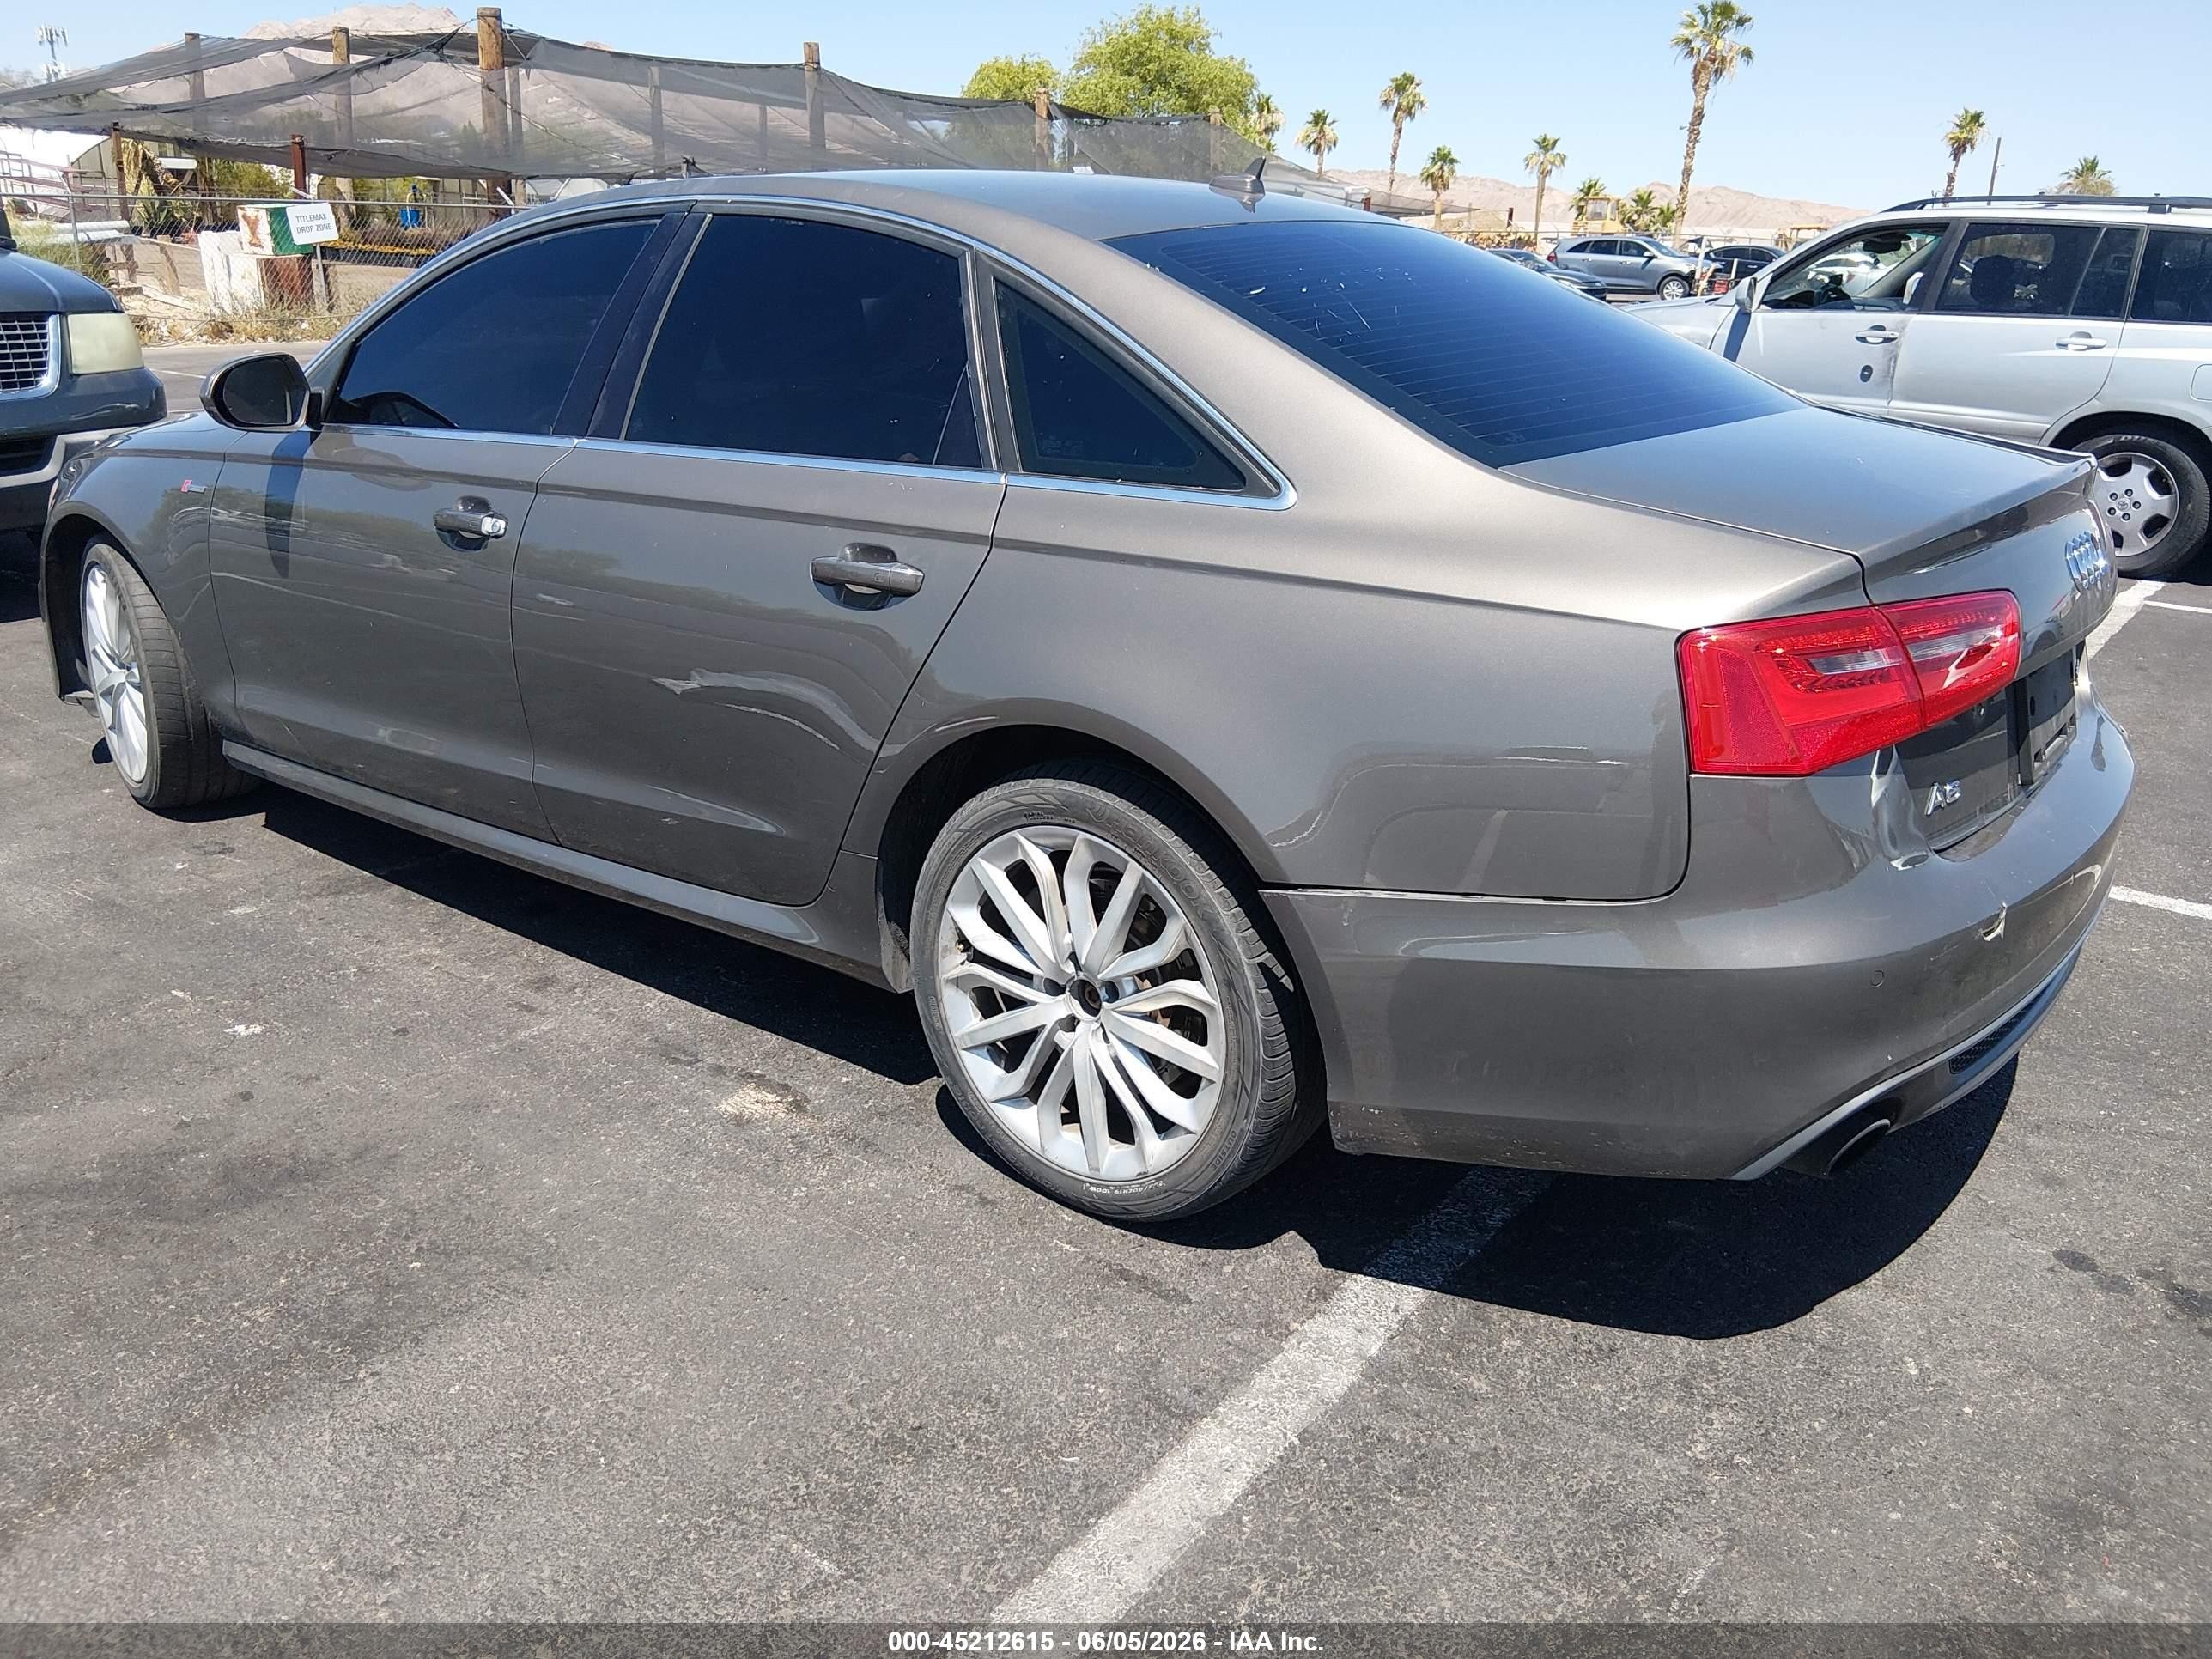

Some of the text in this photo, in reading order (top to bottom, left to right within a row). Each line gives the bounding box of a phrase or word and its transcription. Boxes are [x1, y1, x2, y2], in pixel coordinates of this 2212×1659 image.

[295, 213, 327, 223] TITLEMAX
[296, 222, 333, 234] DROP ZONE
[1924, 780, 1961, 816] A6
[1211, 1129, 1237, 1171] OUTSIDE
